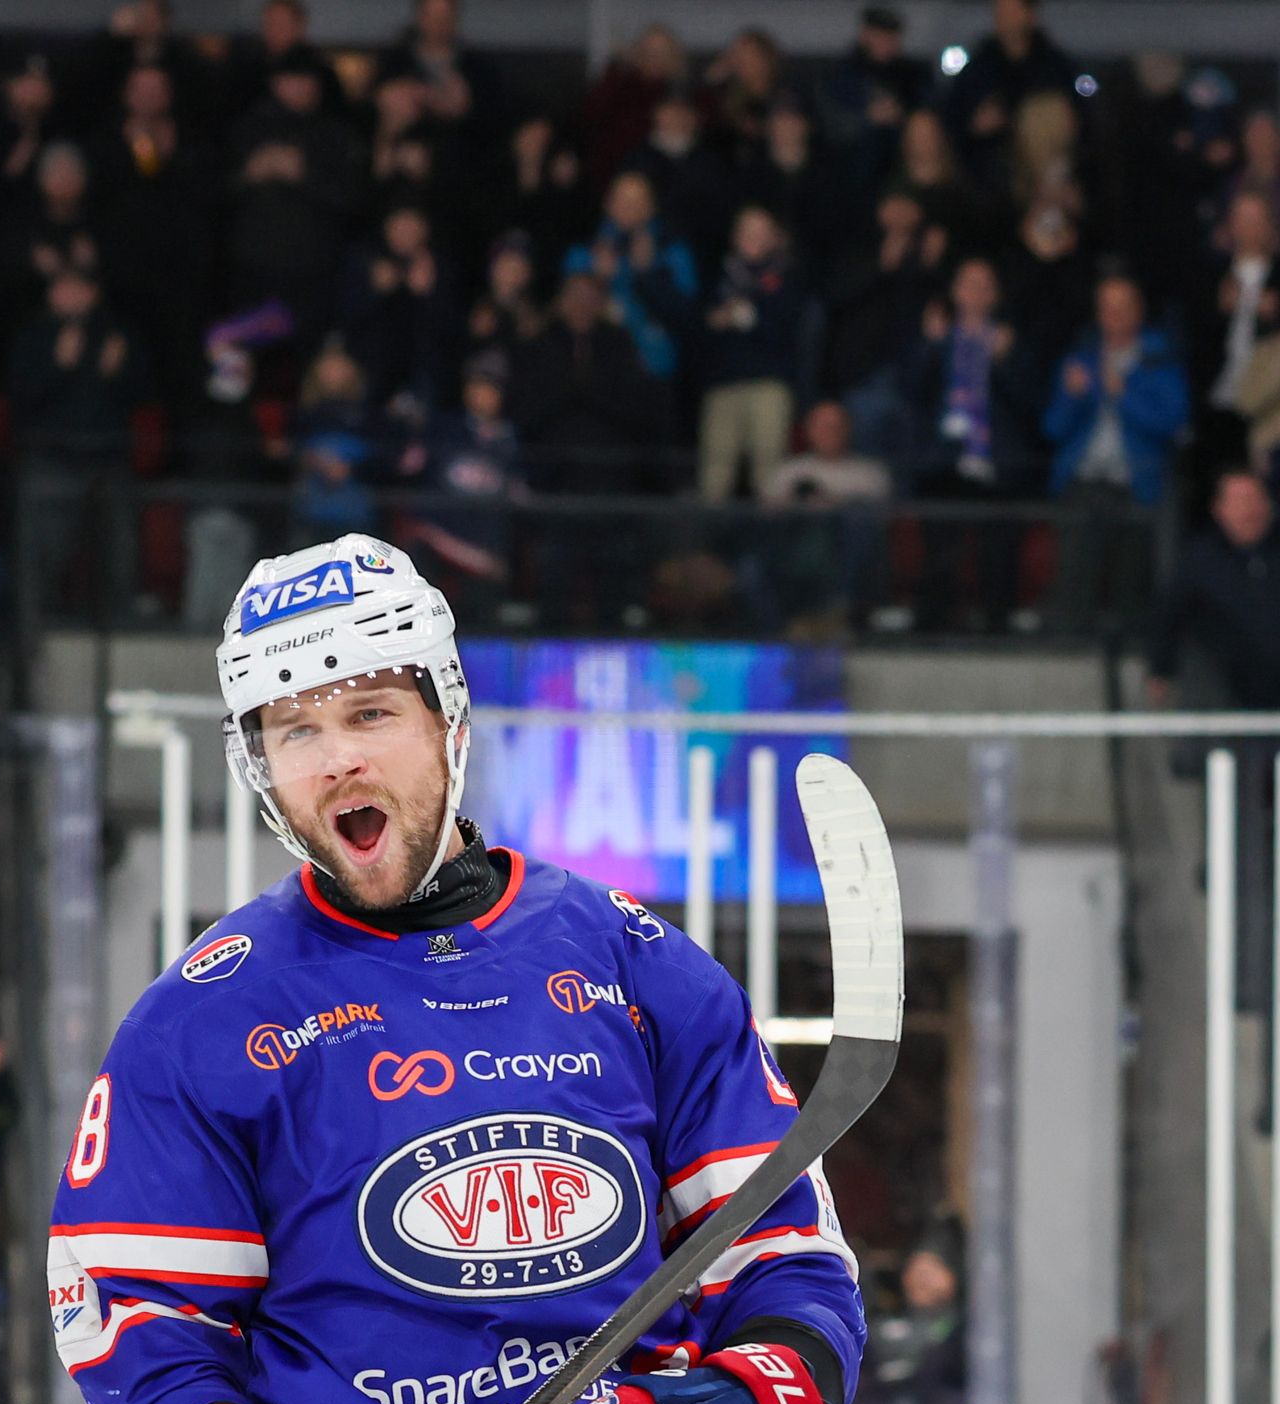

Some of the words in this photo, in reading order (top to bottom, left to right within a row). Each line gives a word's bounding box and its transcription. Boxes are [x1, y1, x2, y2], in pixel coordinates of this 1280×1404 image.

[250, 568, 351, 618] VISA
[265, 628, 334, 657] BAUER
[185, 940, 247, 975] PEPSI
[282, 1003, 384, 1051] ONEPARK
[464, 1050, 602, 1081] Crayon
[66, 1072, 112, 1189] 8
[414, 1123, 584, 1171] STIFTET
[460, 1250, 585, 1286] 29-7-13
